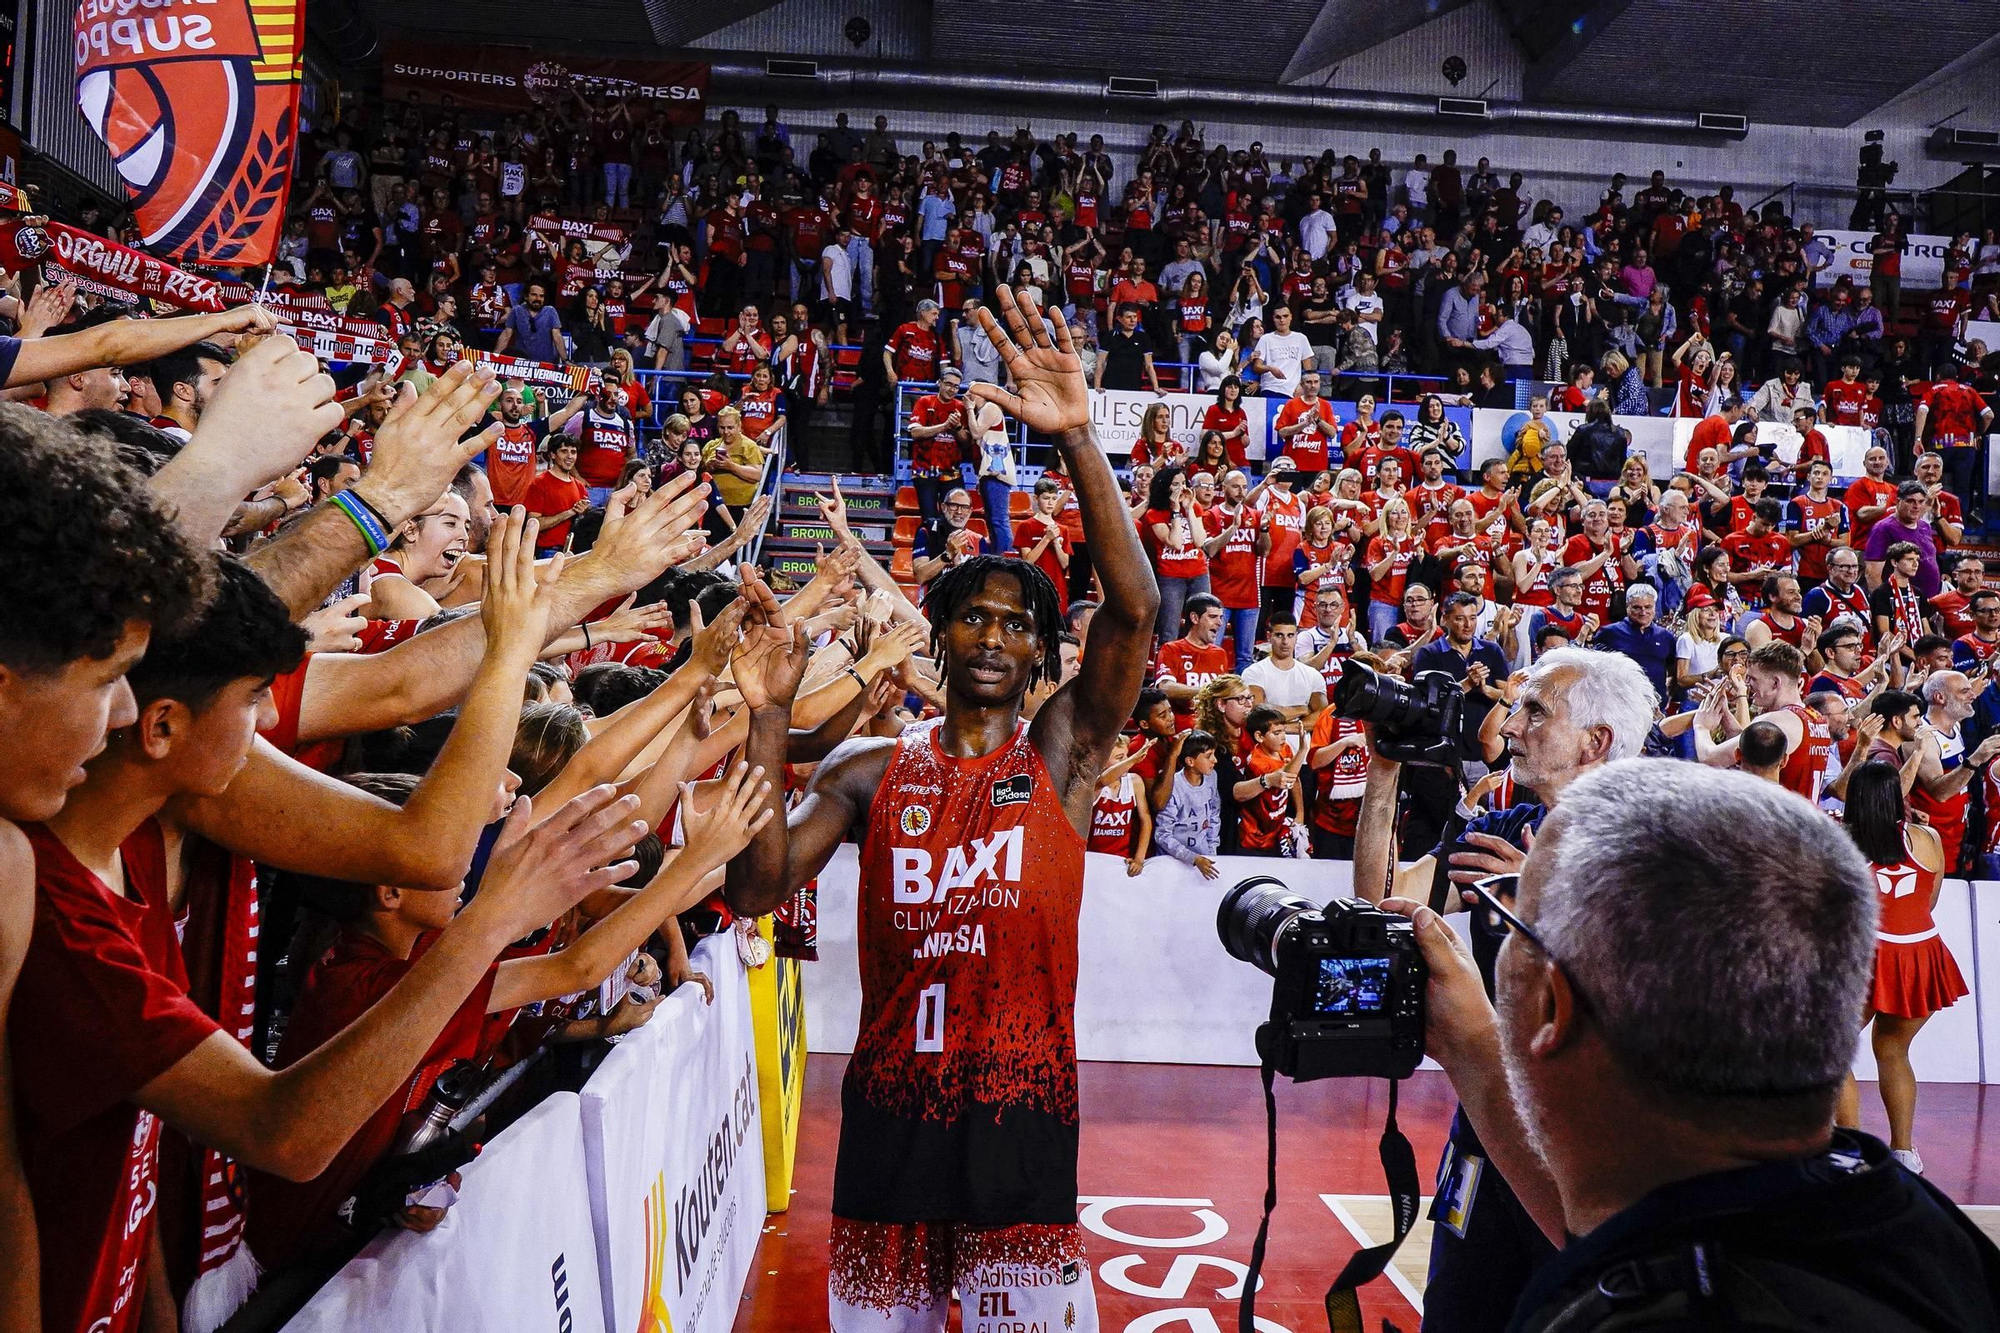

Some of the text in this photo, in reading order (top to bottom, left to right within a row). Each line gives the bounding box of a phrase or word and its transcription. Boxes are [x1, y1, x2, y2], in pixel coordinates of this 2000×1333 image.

[393, 63, 517, 87] SUPPORTERS
[561, 219, 594, 235] BAXI
[57, 231, 141, 284] ORGULL
[948, 259, 968, 272] BAXI
[1071, 266, 1092, 275] BAXI
[301, 310, 343, 328] BAXI
[505, 365, 532, 379] MAREA
[534, 368, 574, 386] VERMELLA
[496, 437, 533, 454] BAXI
[593, 430, 627, 446] BAXI
[1327, 450, 1345, 458] ESA
[798, 496, 881, 509] BRO TAILOR
[1275, 513, 1300, 528] BAX
[791, 528, 834, 539] BROWN
[1222, 528, 1255, 542] AXI
[782, 561, 818, 573] BROW
[996, 785, 1011, 797] liga
[1094, 809, 1132, 827] BAXI
[1093, 828, 1125, 837] MANRESA
[891, 825, 1025, 904] BAXI
[915, 983, 946, 1052] 0
[674, 1051, 756, 1299] Kouten.cat
[1400, 1193, 1414, 1234] Nikon
[1064, 1272, 1078, 1284] acb
[978, 1291, 1017, 1318] ETL
